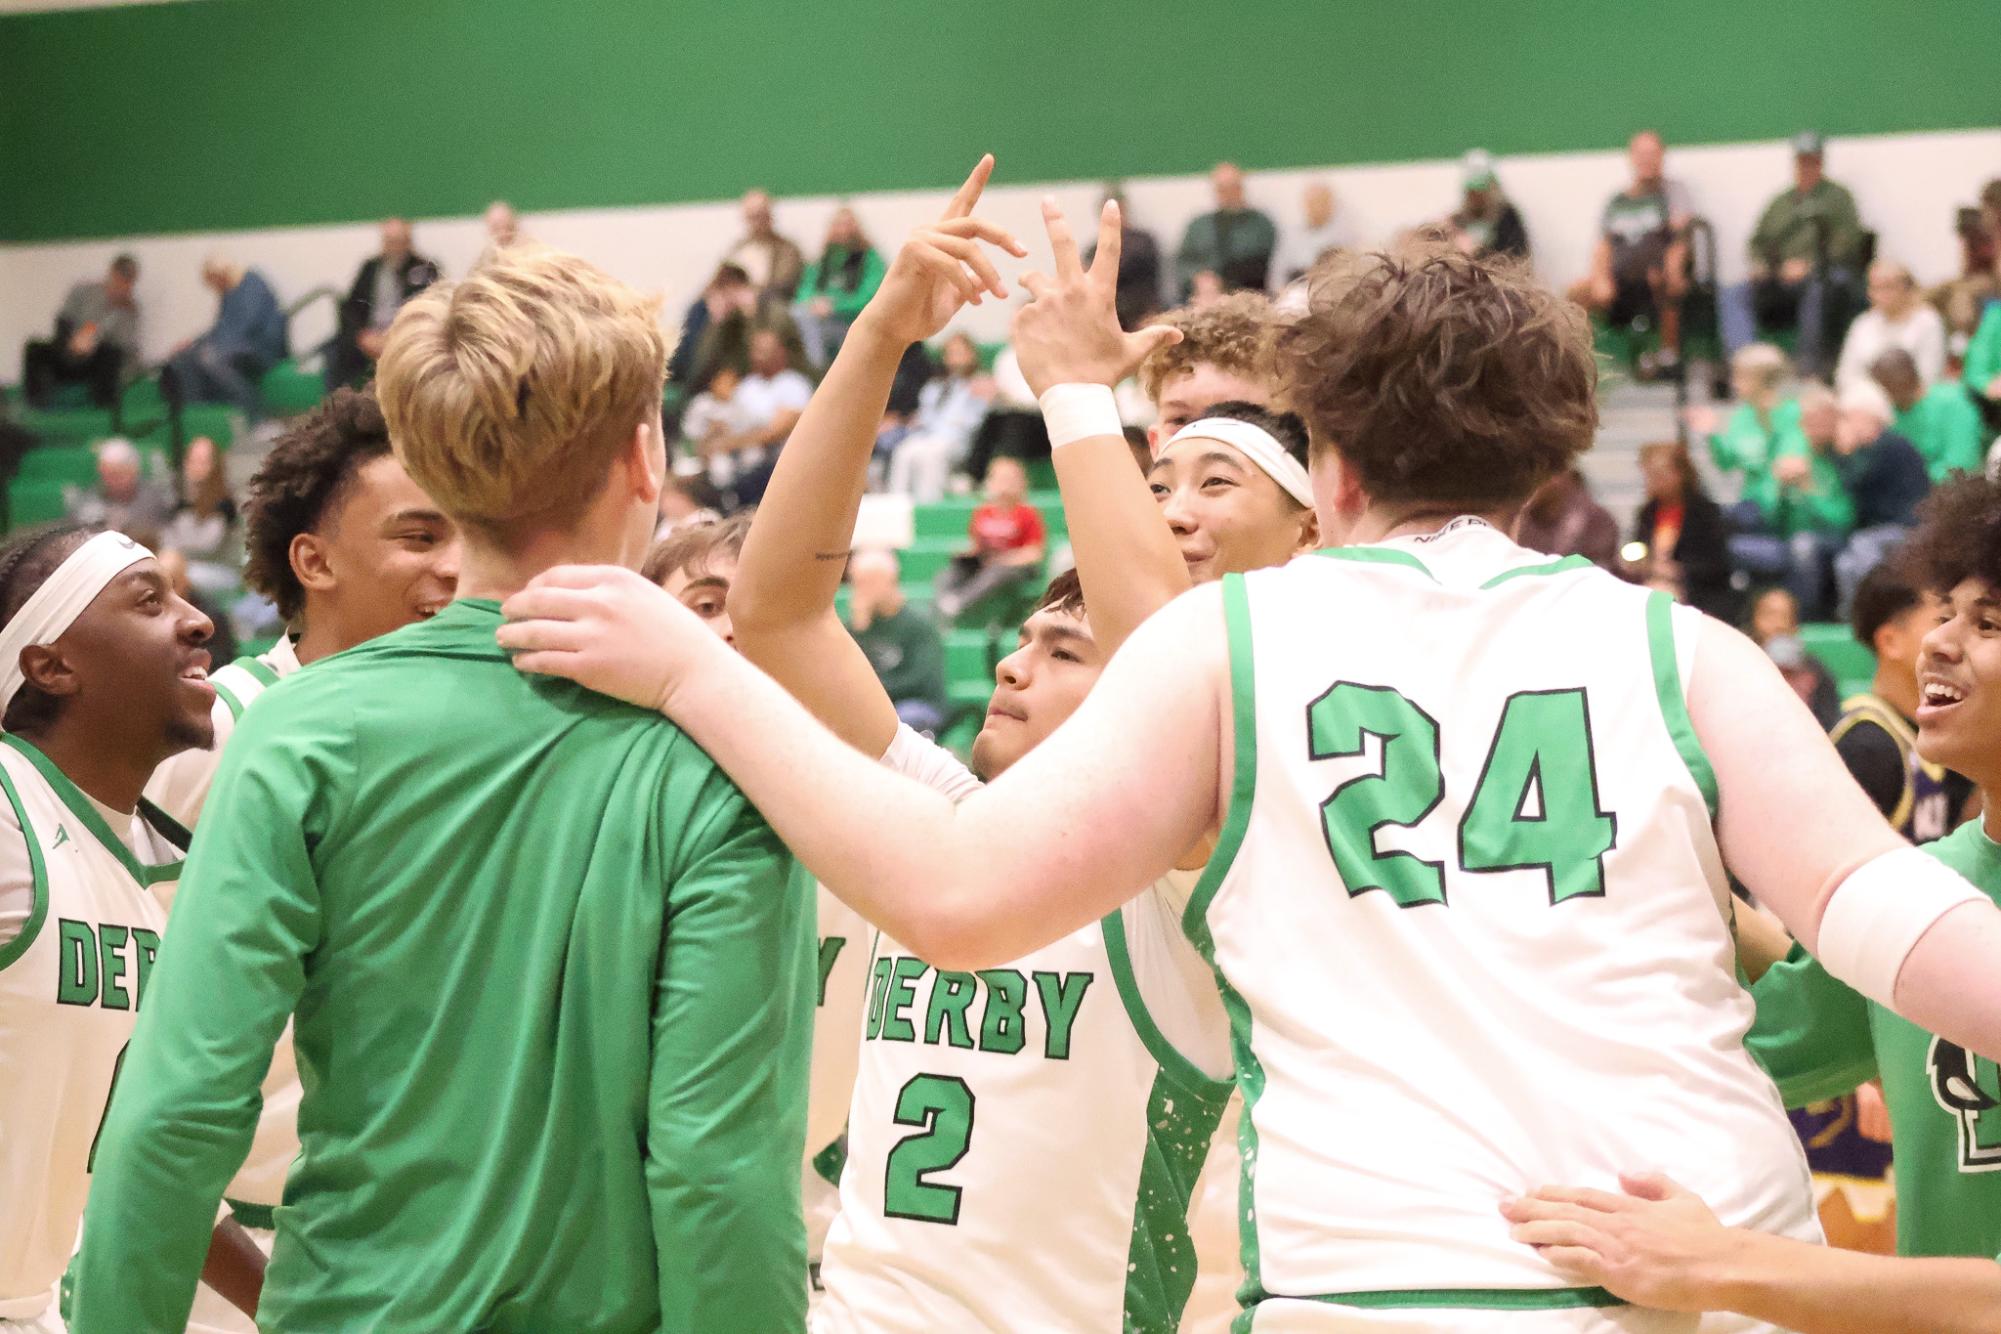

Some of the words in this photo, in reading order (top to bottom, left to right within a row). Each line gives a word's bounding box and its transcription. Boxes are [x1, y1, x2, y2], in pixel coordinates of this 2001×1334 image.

[1306, 680, 1617, 908] 24
[866, 957, 1094, 1060] DERBY
[884, 1072, 976, 1226] 2
